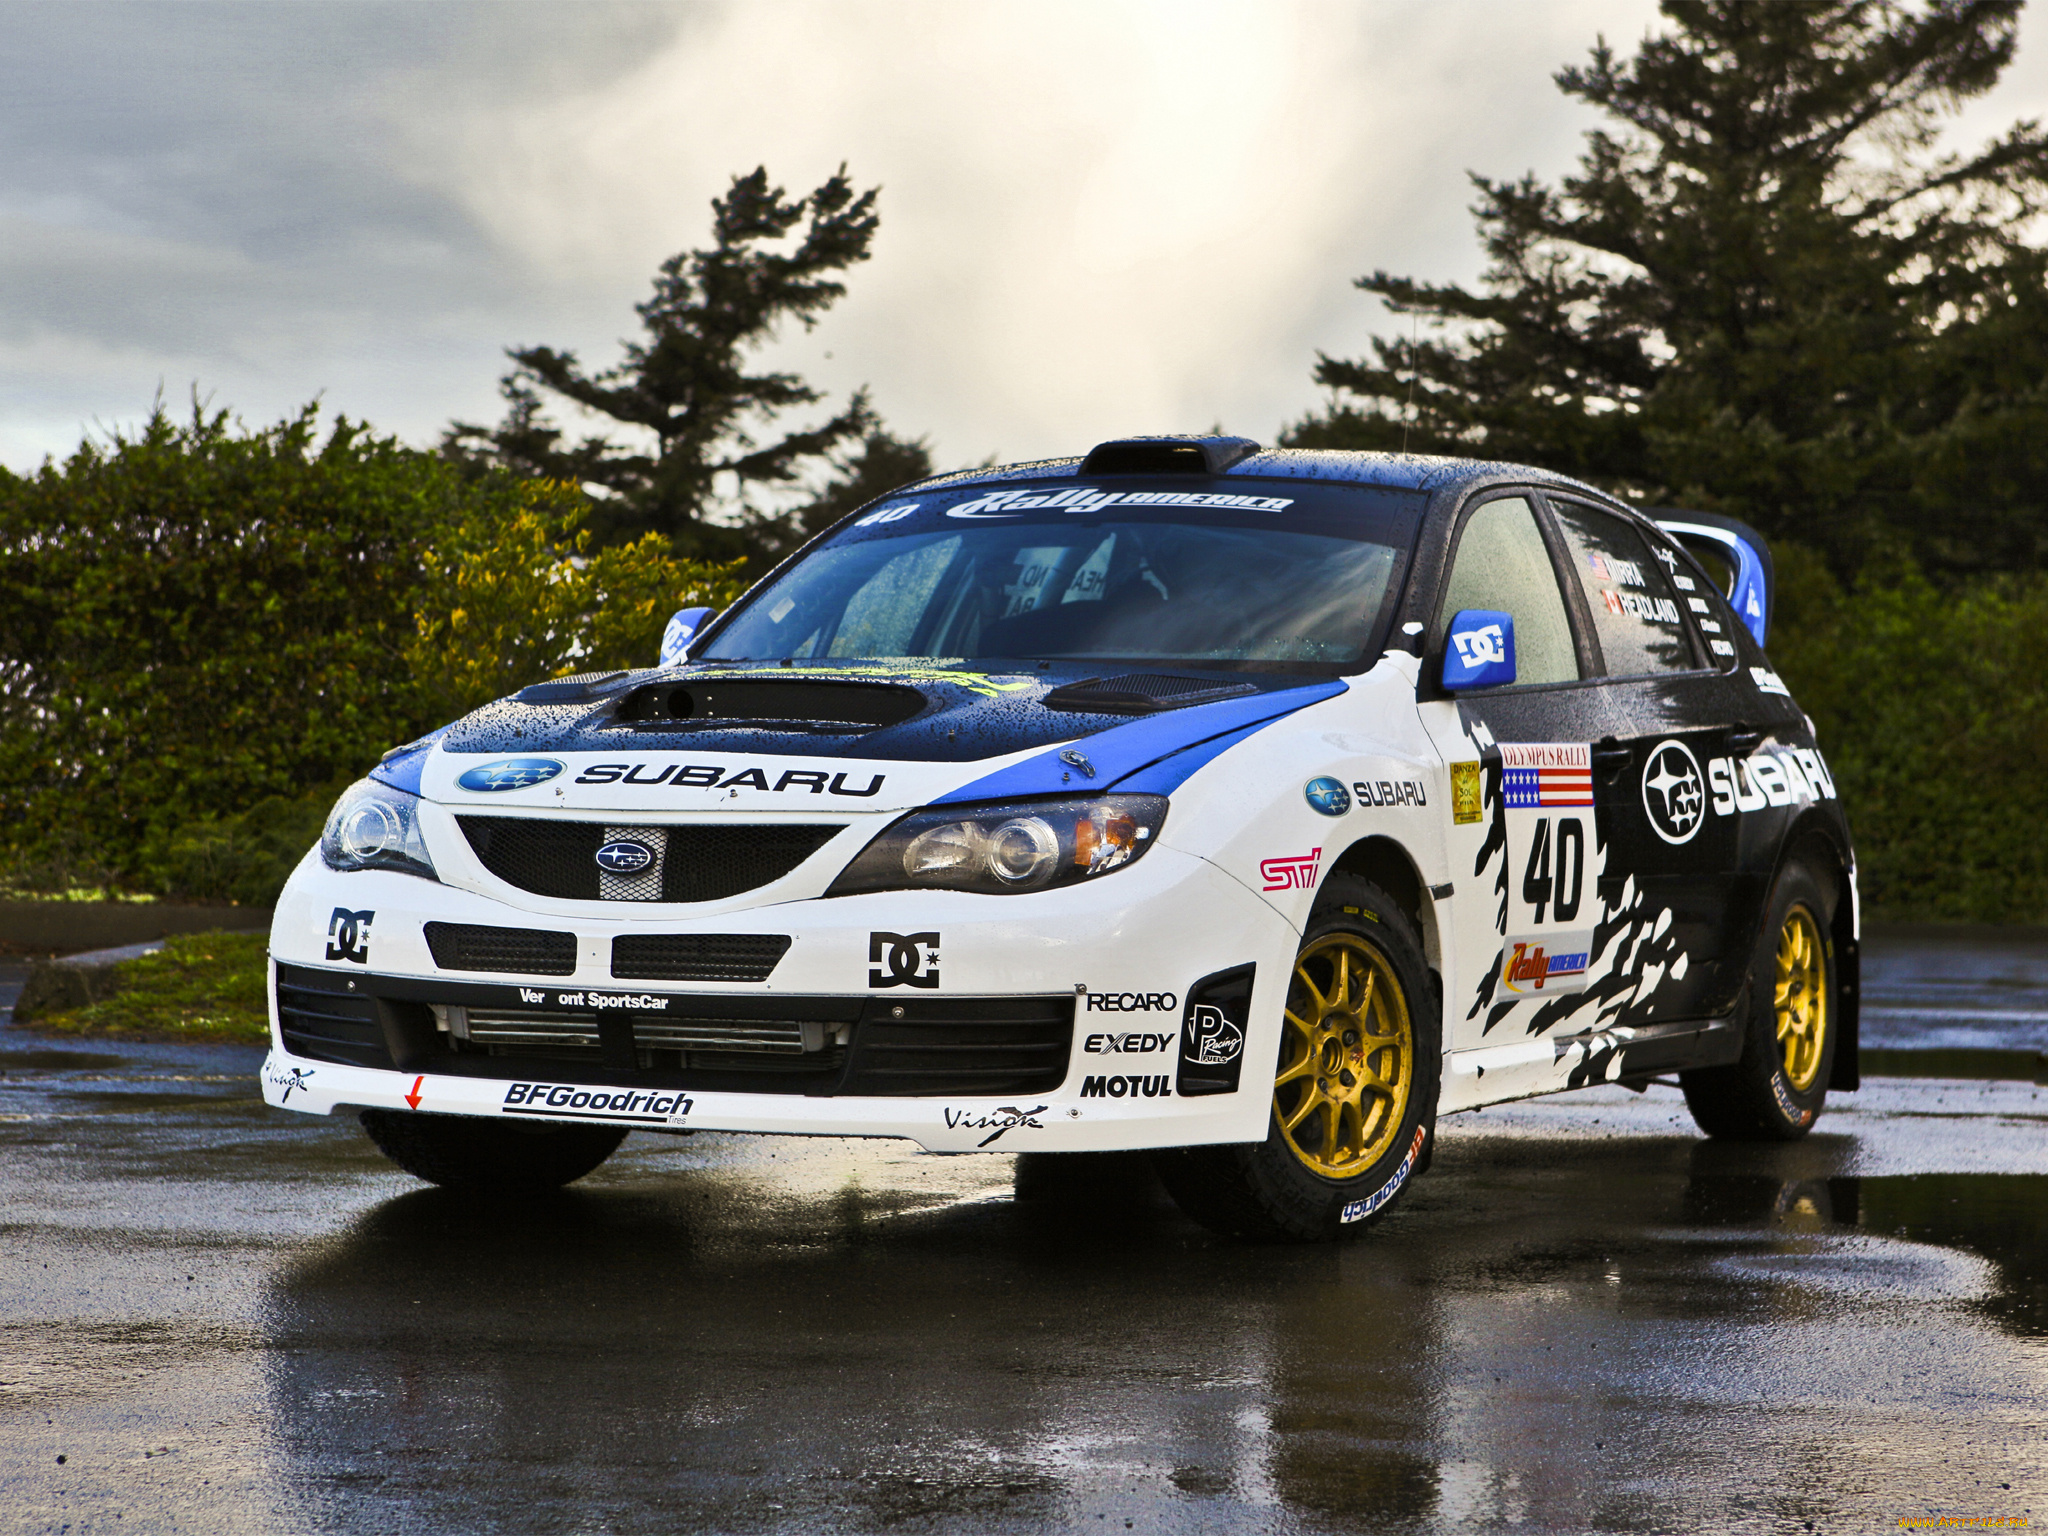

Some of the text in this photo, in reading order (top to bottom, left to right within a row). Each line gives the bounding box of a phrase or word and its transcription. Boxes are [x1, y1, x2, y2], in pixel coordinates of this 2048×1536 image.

[854, 503, 920, 527] 40
[965, 488, 1295, 517] Rally AMERICA
[1604, 558, 1646, 587] MIRRA
[1618, 593, 1680, 624] HEADLAND
[1503, 746, 1588, 766] OLYMPUS RALLY
[574, 763, 887, 798] SUBARU
[1453, 764, 1476, 774] DANZA
[1353, 781, 1427, 807] SUBARU
[1708, 748, 1837, 816] SUBARU
[1523, 817, 1584, 924] 40
[1507, 942, 1588, 989] Rally AMERICA
[588, 992, 669, 1009] SportsCar
[1087, 992, 1177, 1012] RECARO
[1084, 1032, 1176, 1055] EXEDY
[1203, 1036, 1241, 1055] Racing
[1202, 1055, 1228, 1064] FUELS
[1080, 1075, 1172, 1098] MOTUL
[504, 1083, 694, 1116] BFGoodrich
[668, 1115, 687, 1125] Tires
[1343, 1127, 1425, 1221] BFGoodrich
